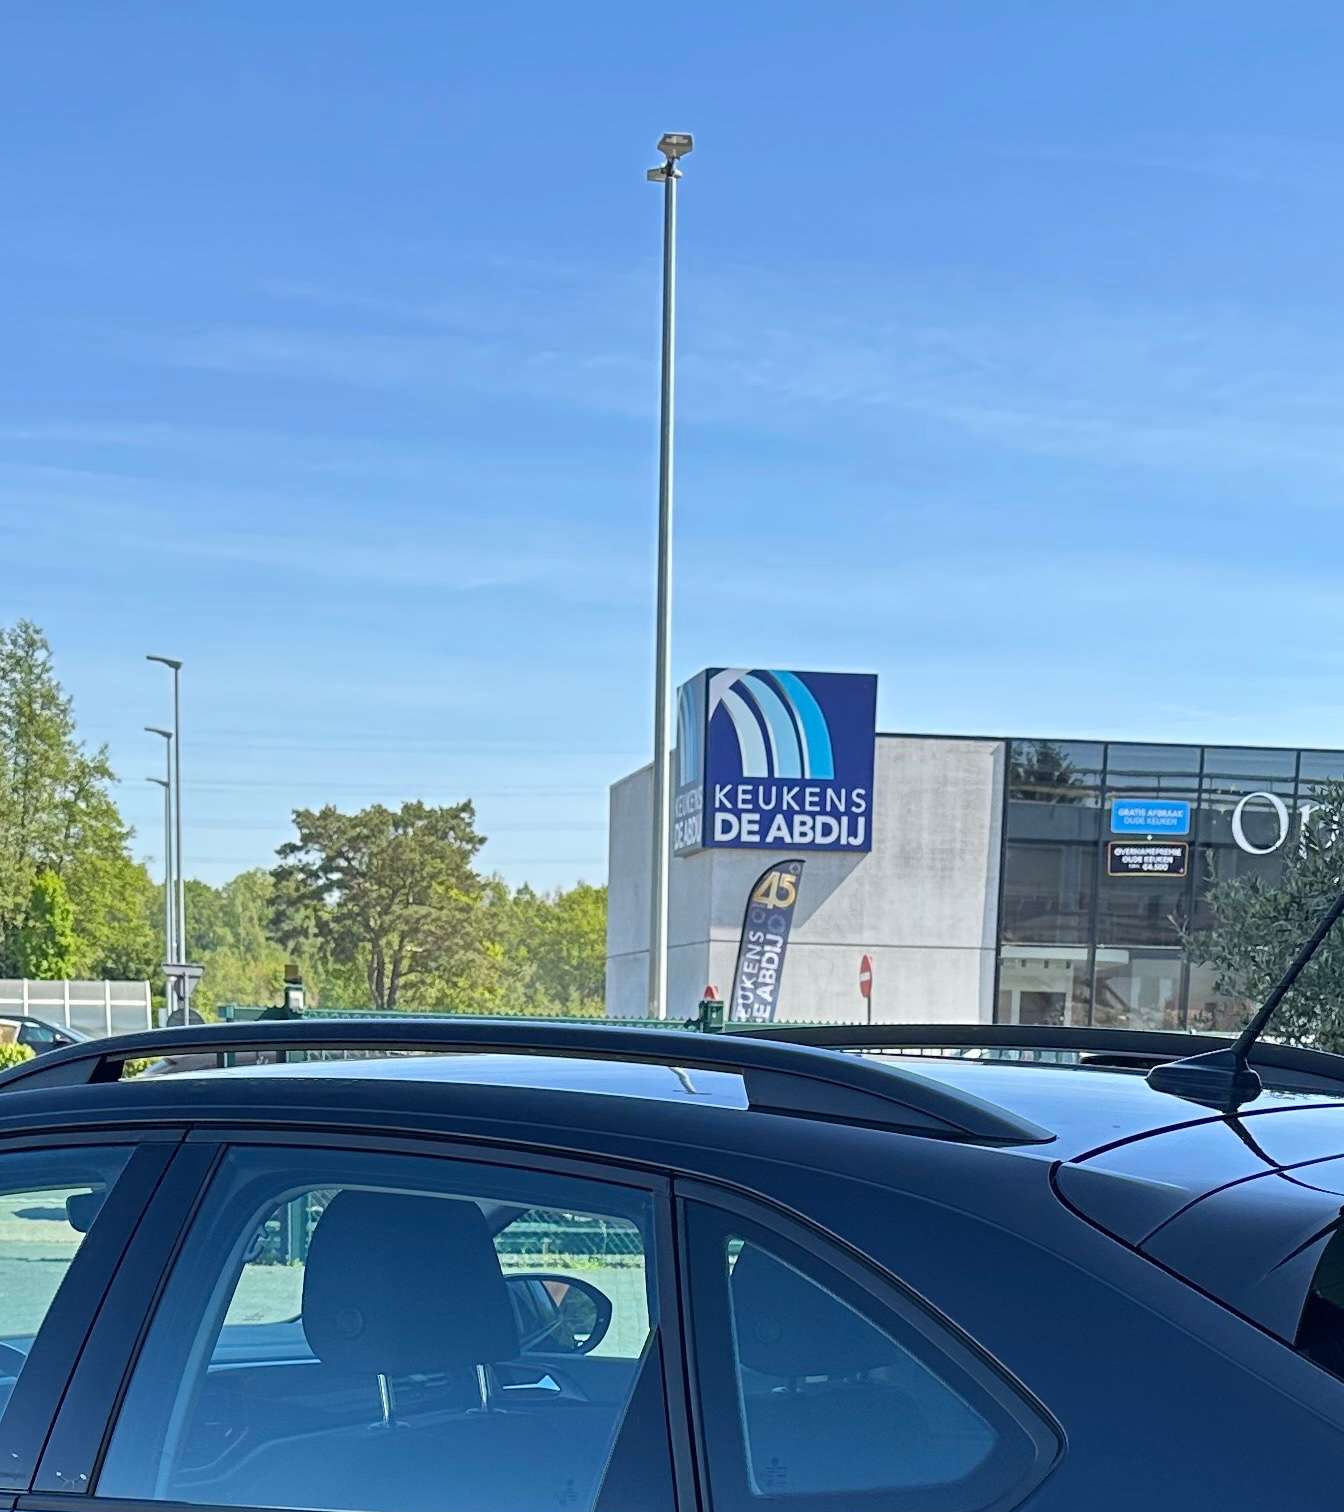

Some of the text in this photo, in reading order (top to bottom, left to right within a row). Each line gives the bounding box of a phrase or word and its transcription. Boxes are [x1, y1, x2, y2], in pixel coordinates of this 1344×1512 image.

[714, 783, 867, 814] KEUKENS
[713, 811, 866, 846] DE ABDIJ
[752, 871, 798, 909] 45
